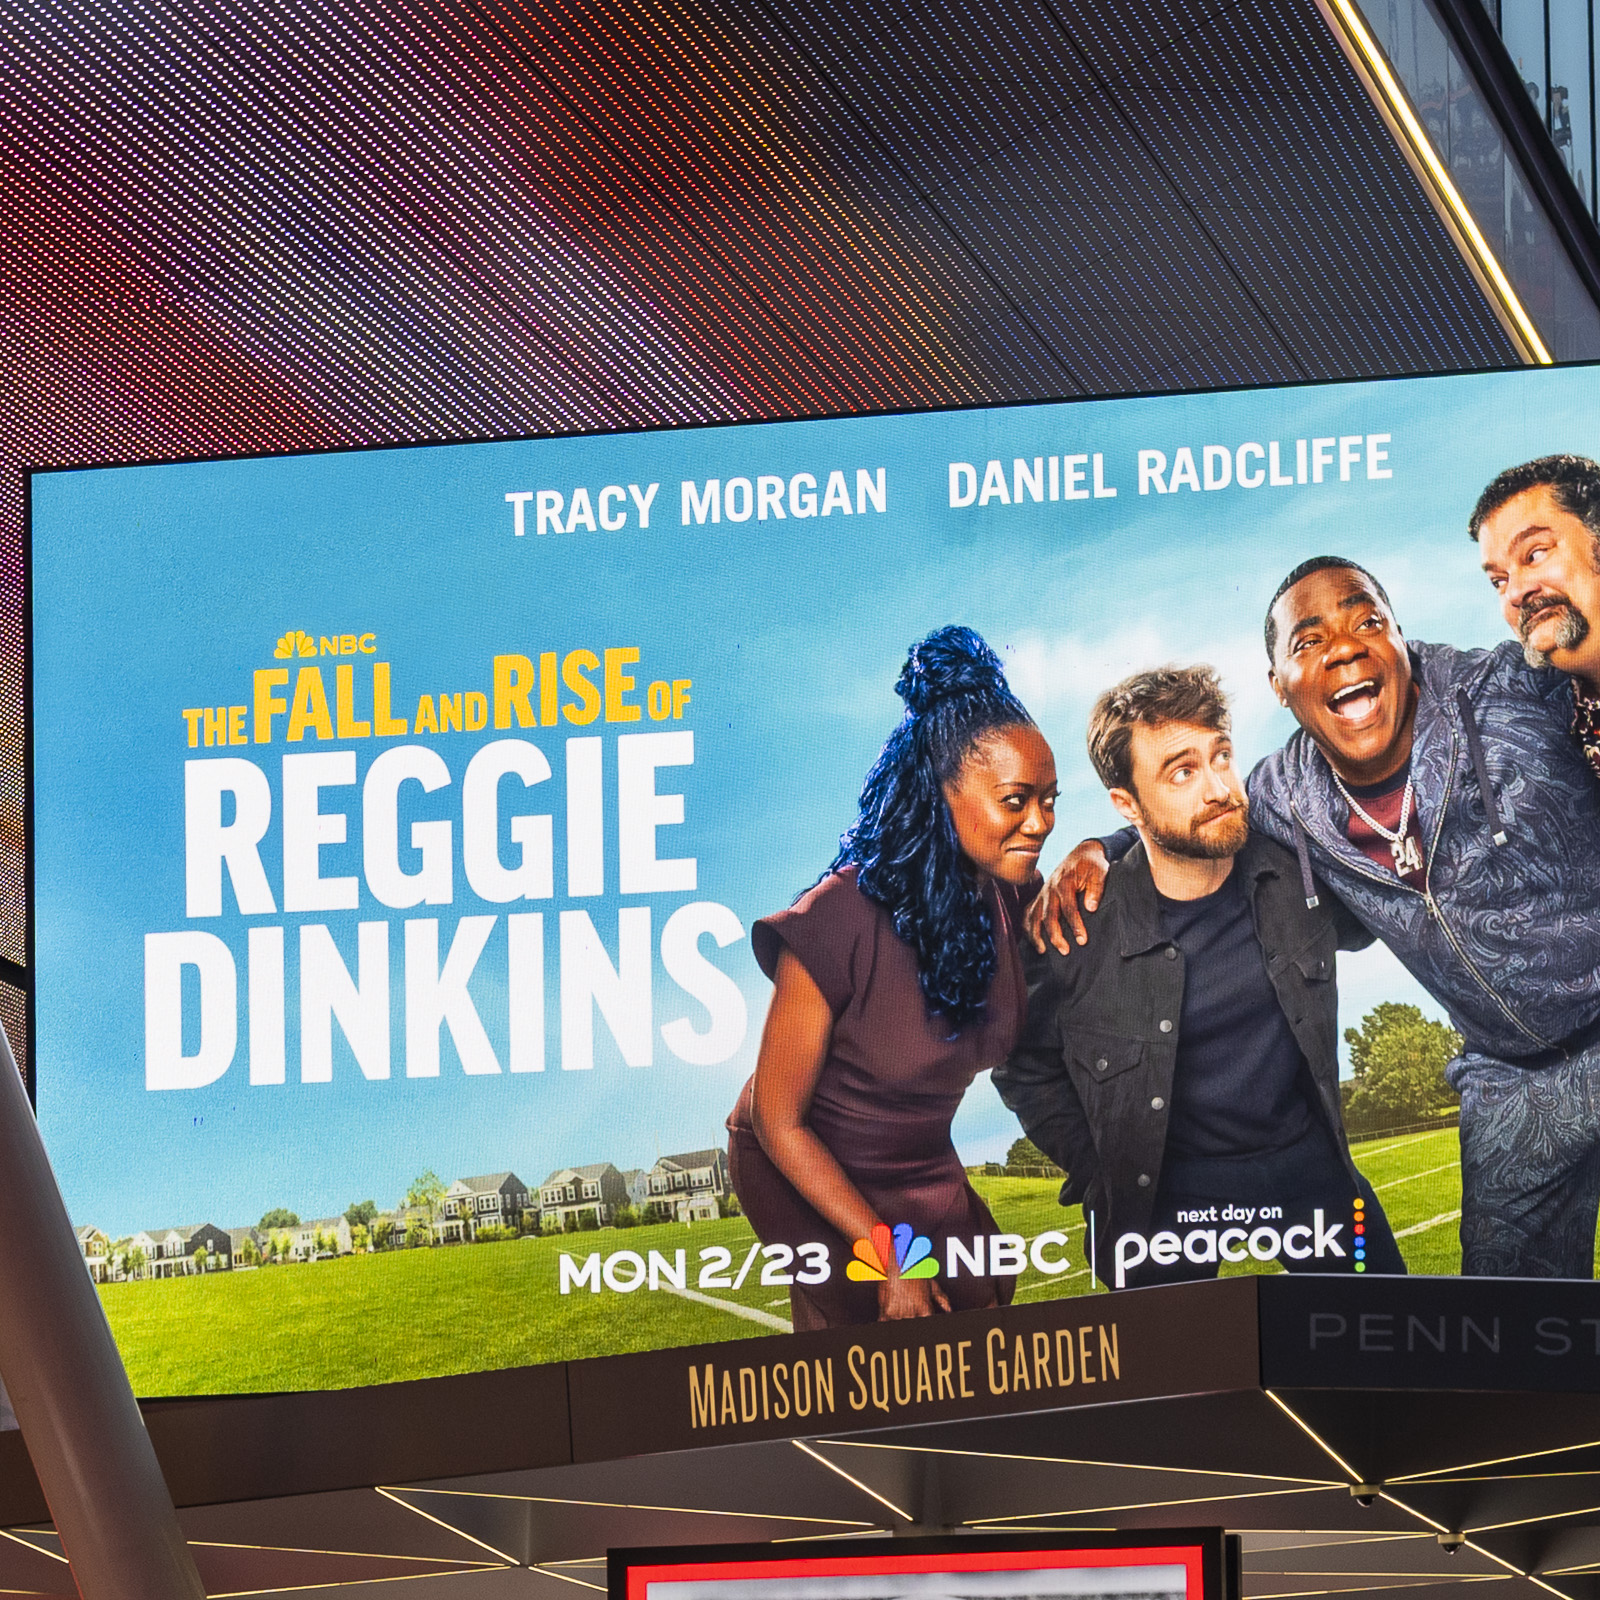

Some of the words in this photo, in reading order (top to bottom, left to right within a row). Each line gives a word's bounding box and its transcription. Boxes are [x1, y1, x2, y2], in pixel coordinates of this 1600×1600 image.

[506, 483, 660, 536] TRACY
[681, 468, 888, 526] MORGAN
[947, 453, 1117, 510] DANIEL
[1137, 434, 1392, 495] RADCLIFFE
[319, 633, 377, 655] NBC
[183, 705, 248, 748] THE
[252, 661, 407, 744] FALL
[414, 691, 488, 735] AND
[493, 647, 642, 729] RISE
[647, 678, 693, 721] OF
[184, 731, 698, 918] REGGIE
[143, 901, 748, 1092] DINKINS
[1115, 1208, 1346, 1288] peacock
[1176, 1204, 1220, 1223] next
[1223, 1203, 1256, 1224] day
[1261, 1206, 1283, 1219] on
[558, 1248, 687, 1295] MON
[698, 1241, 832, 1290] 2/23
[946, 1229, 1070, 1278] NBC
[1308, 1312, 1500, 1354] PENN
[688, 1356, 836, 1430] MADISON
[847, 1338, 977, 1414] SQUARE
[986, 1322, 1121, 1396] GARDEN
